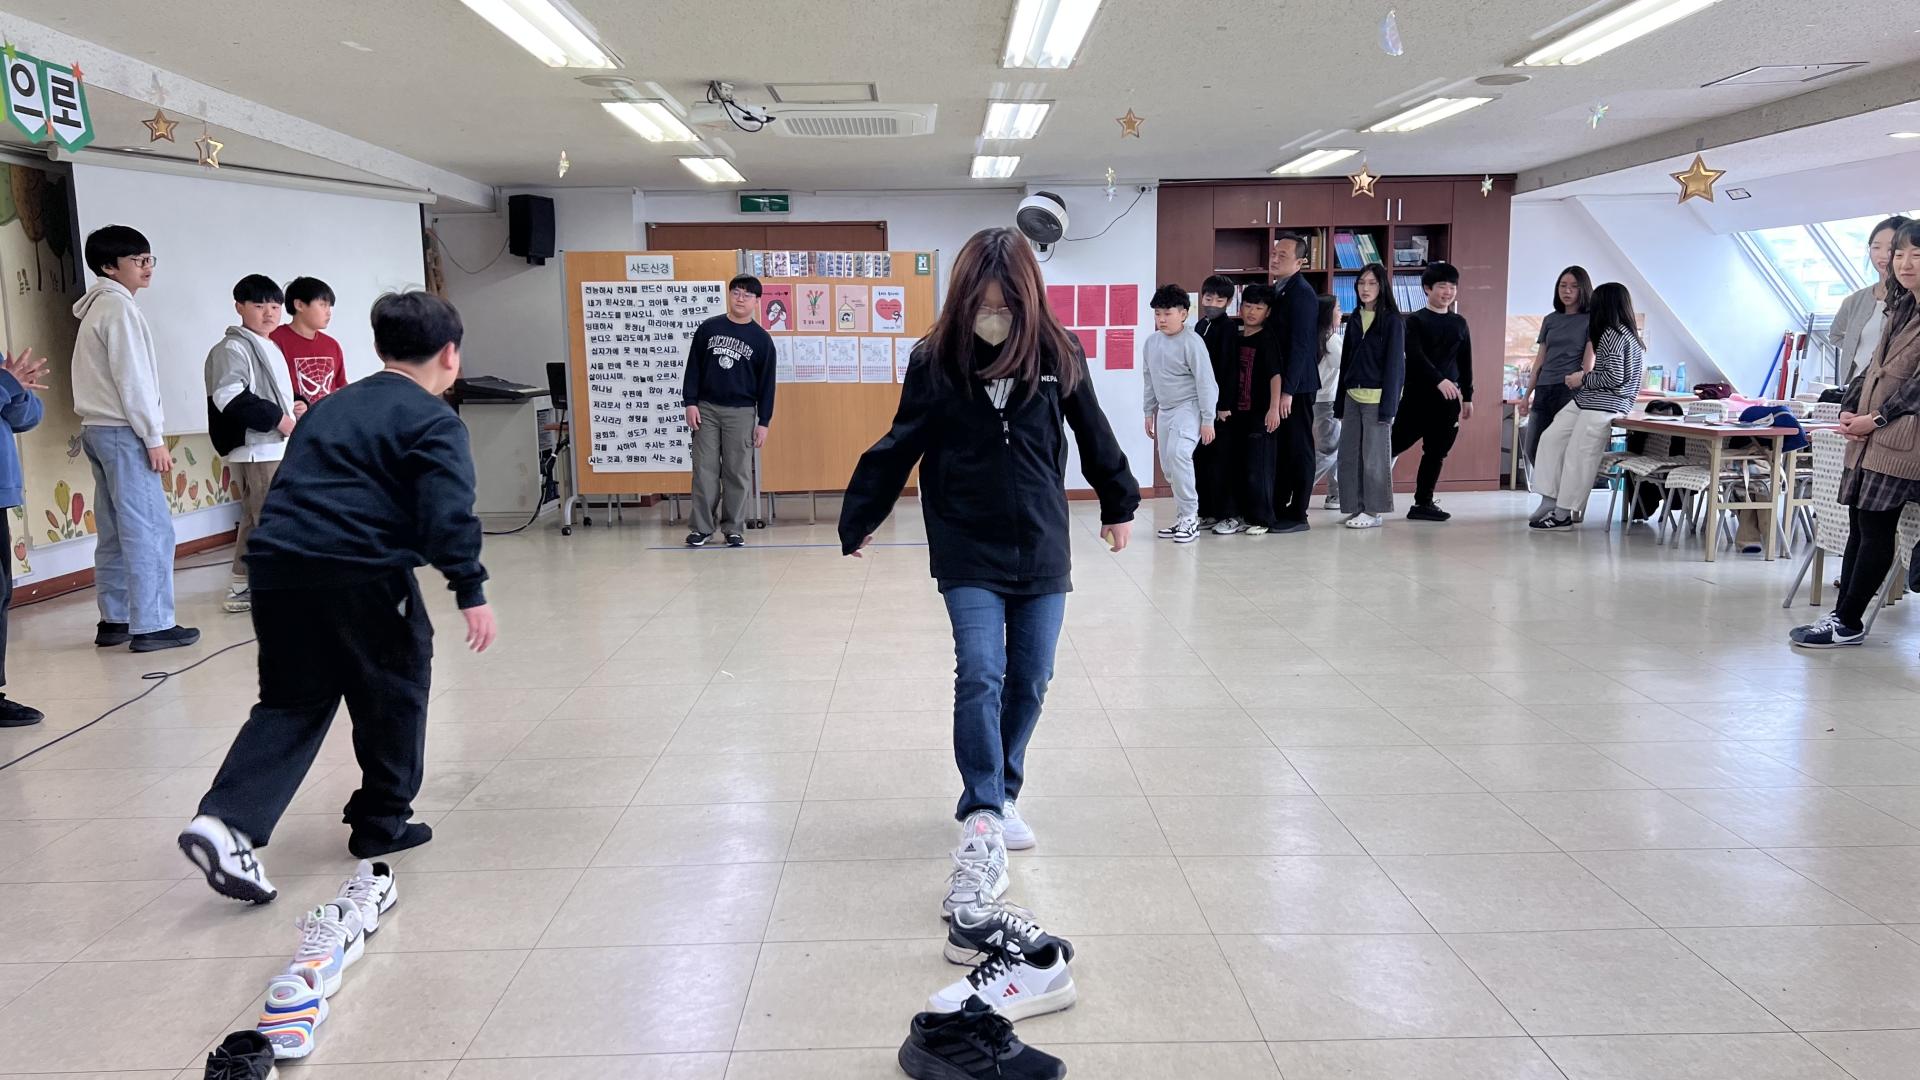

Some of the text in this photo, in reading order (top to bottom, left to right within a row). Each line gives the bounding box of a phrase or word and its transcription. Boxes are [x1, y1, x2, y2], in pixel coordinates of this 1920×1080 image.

[10, 63, 82, 129] 으로
[630, 263, 669, 274] 사도신경
[641, 285, 662, 293] 만드신
[666, 285, 688, 293] 하나님
[693, 285, 720, 293] 아버지를
[588, 299, 602, 307] 내가
[638, 299, 645, 307] 그
[706, 296, 720, 304] 예수
[586, 311, 621, 319] 그리스도를
[660, 308, 674, 316] 이는
[681, 306, 709, 315] 성령으로
[648, 319, 683, 329] 마리아에게
[590, 334, 611, 343] 본디오
[615, 333, 651, 342] 빌라도에게
[653, 332, 674, 340] 고난을
[591, 347, 619, 355] 십자가에
[623, 346, 631, 354] 못
[707, 335, 754, 361] ENCOURAGE
[713, 347, 741, 361] SOMEDAY
[607, 362, 622, 370] 만에
[625, 360, 639, 368] 죽은
[643, 360, 650, 368] 자
[656, 360, 684, 368] 가운데서
[632, 375, 654, 383] 하늘에
[591, 384, 613, 394] 하나님
[622, 390, 643, 398] 우편에
[593, 401, 620, 409] 저리로서
[625, 401, 632, 409] 산
[635, 401, 649, 409] 자와
[657, 402, 670, 411] 죽은
[594, 414, 622, 425] 오시리라
[628, 415, 648, 423] 성령을
[627, 428, 648, 438] 성도가
[654, 427, 668, 435] 서로
[594, 443, 607, 451] 죄를
[617, 441, 637, 451] 사하여
[645, 440, 666, 449] 주시는
[589, 456, 603, 464] 사는
[626, 455, 647, 463] 영원히
[652, 453, 666, 462] 사는
[669, 455, 683, 464] 것을
